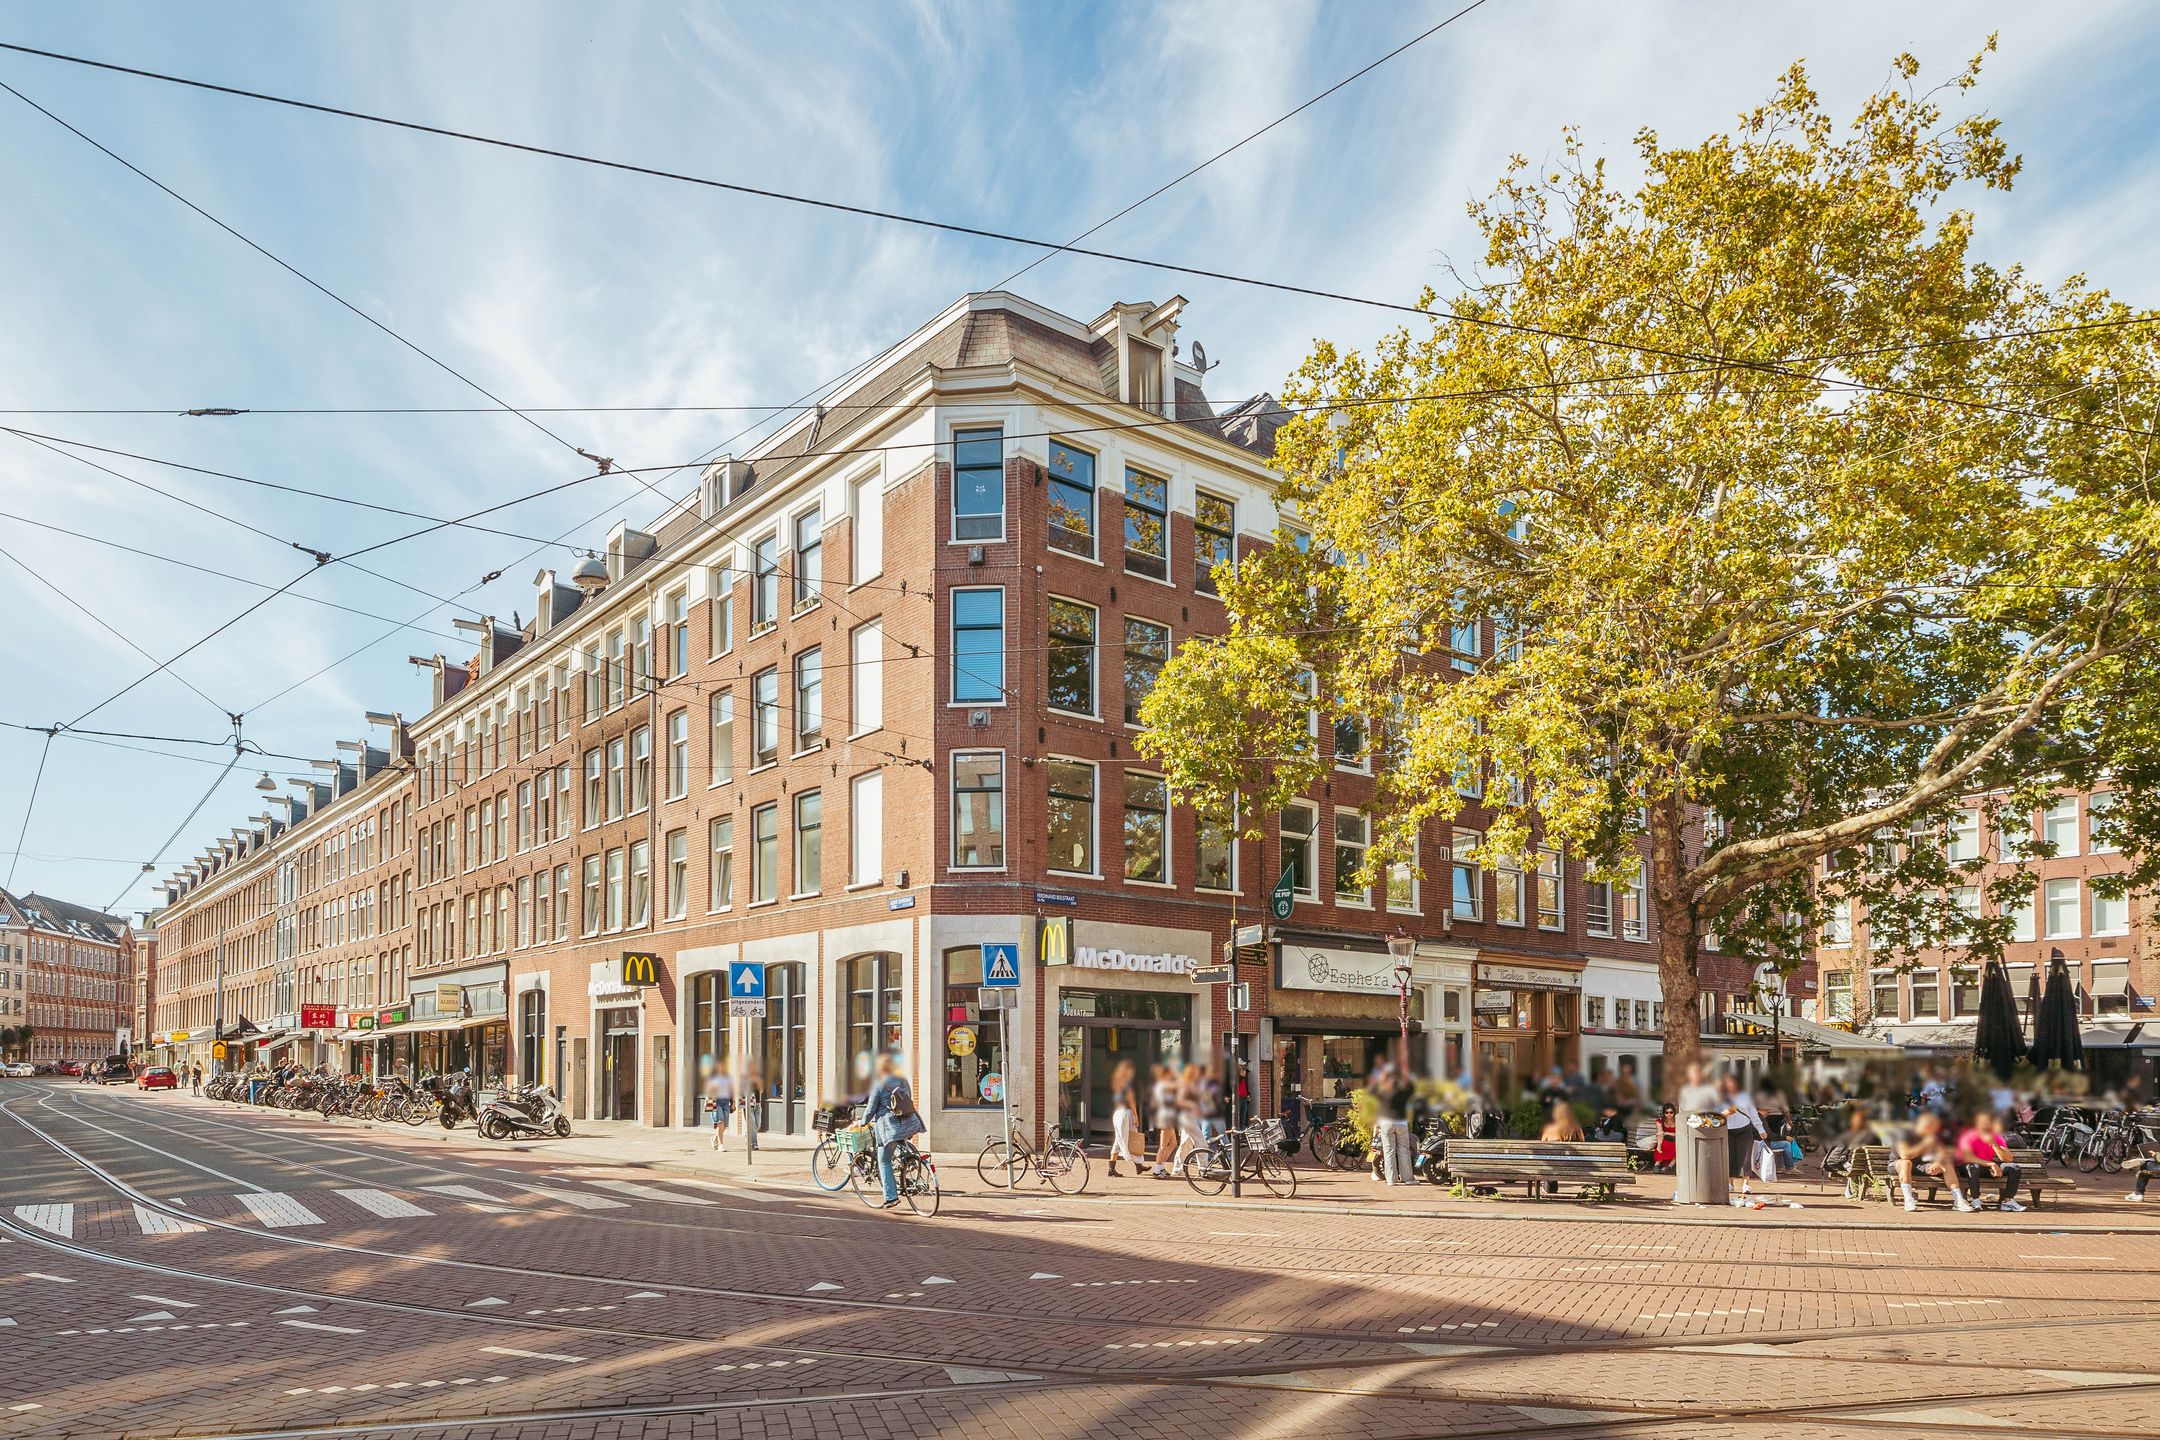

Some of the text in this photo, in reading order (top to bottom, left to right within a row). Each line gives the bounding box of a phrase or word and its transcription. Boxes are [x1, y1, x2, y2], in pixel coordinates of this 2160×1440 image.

[1074, 946, 1198, 975] McDonald's
[1330, 968, 1389, 988] Esphera
[1497, 968, 1524, 982] Toko
